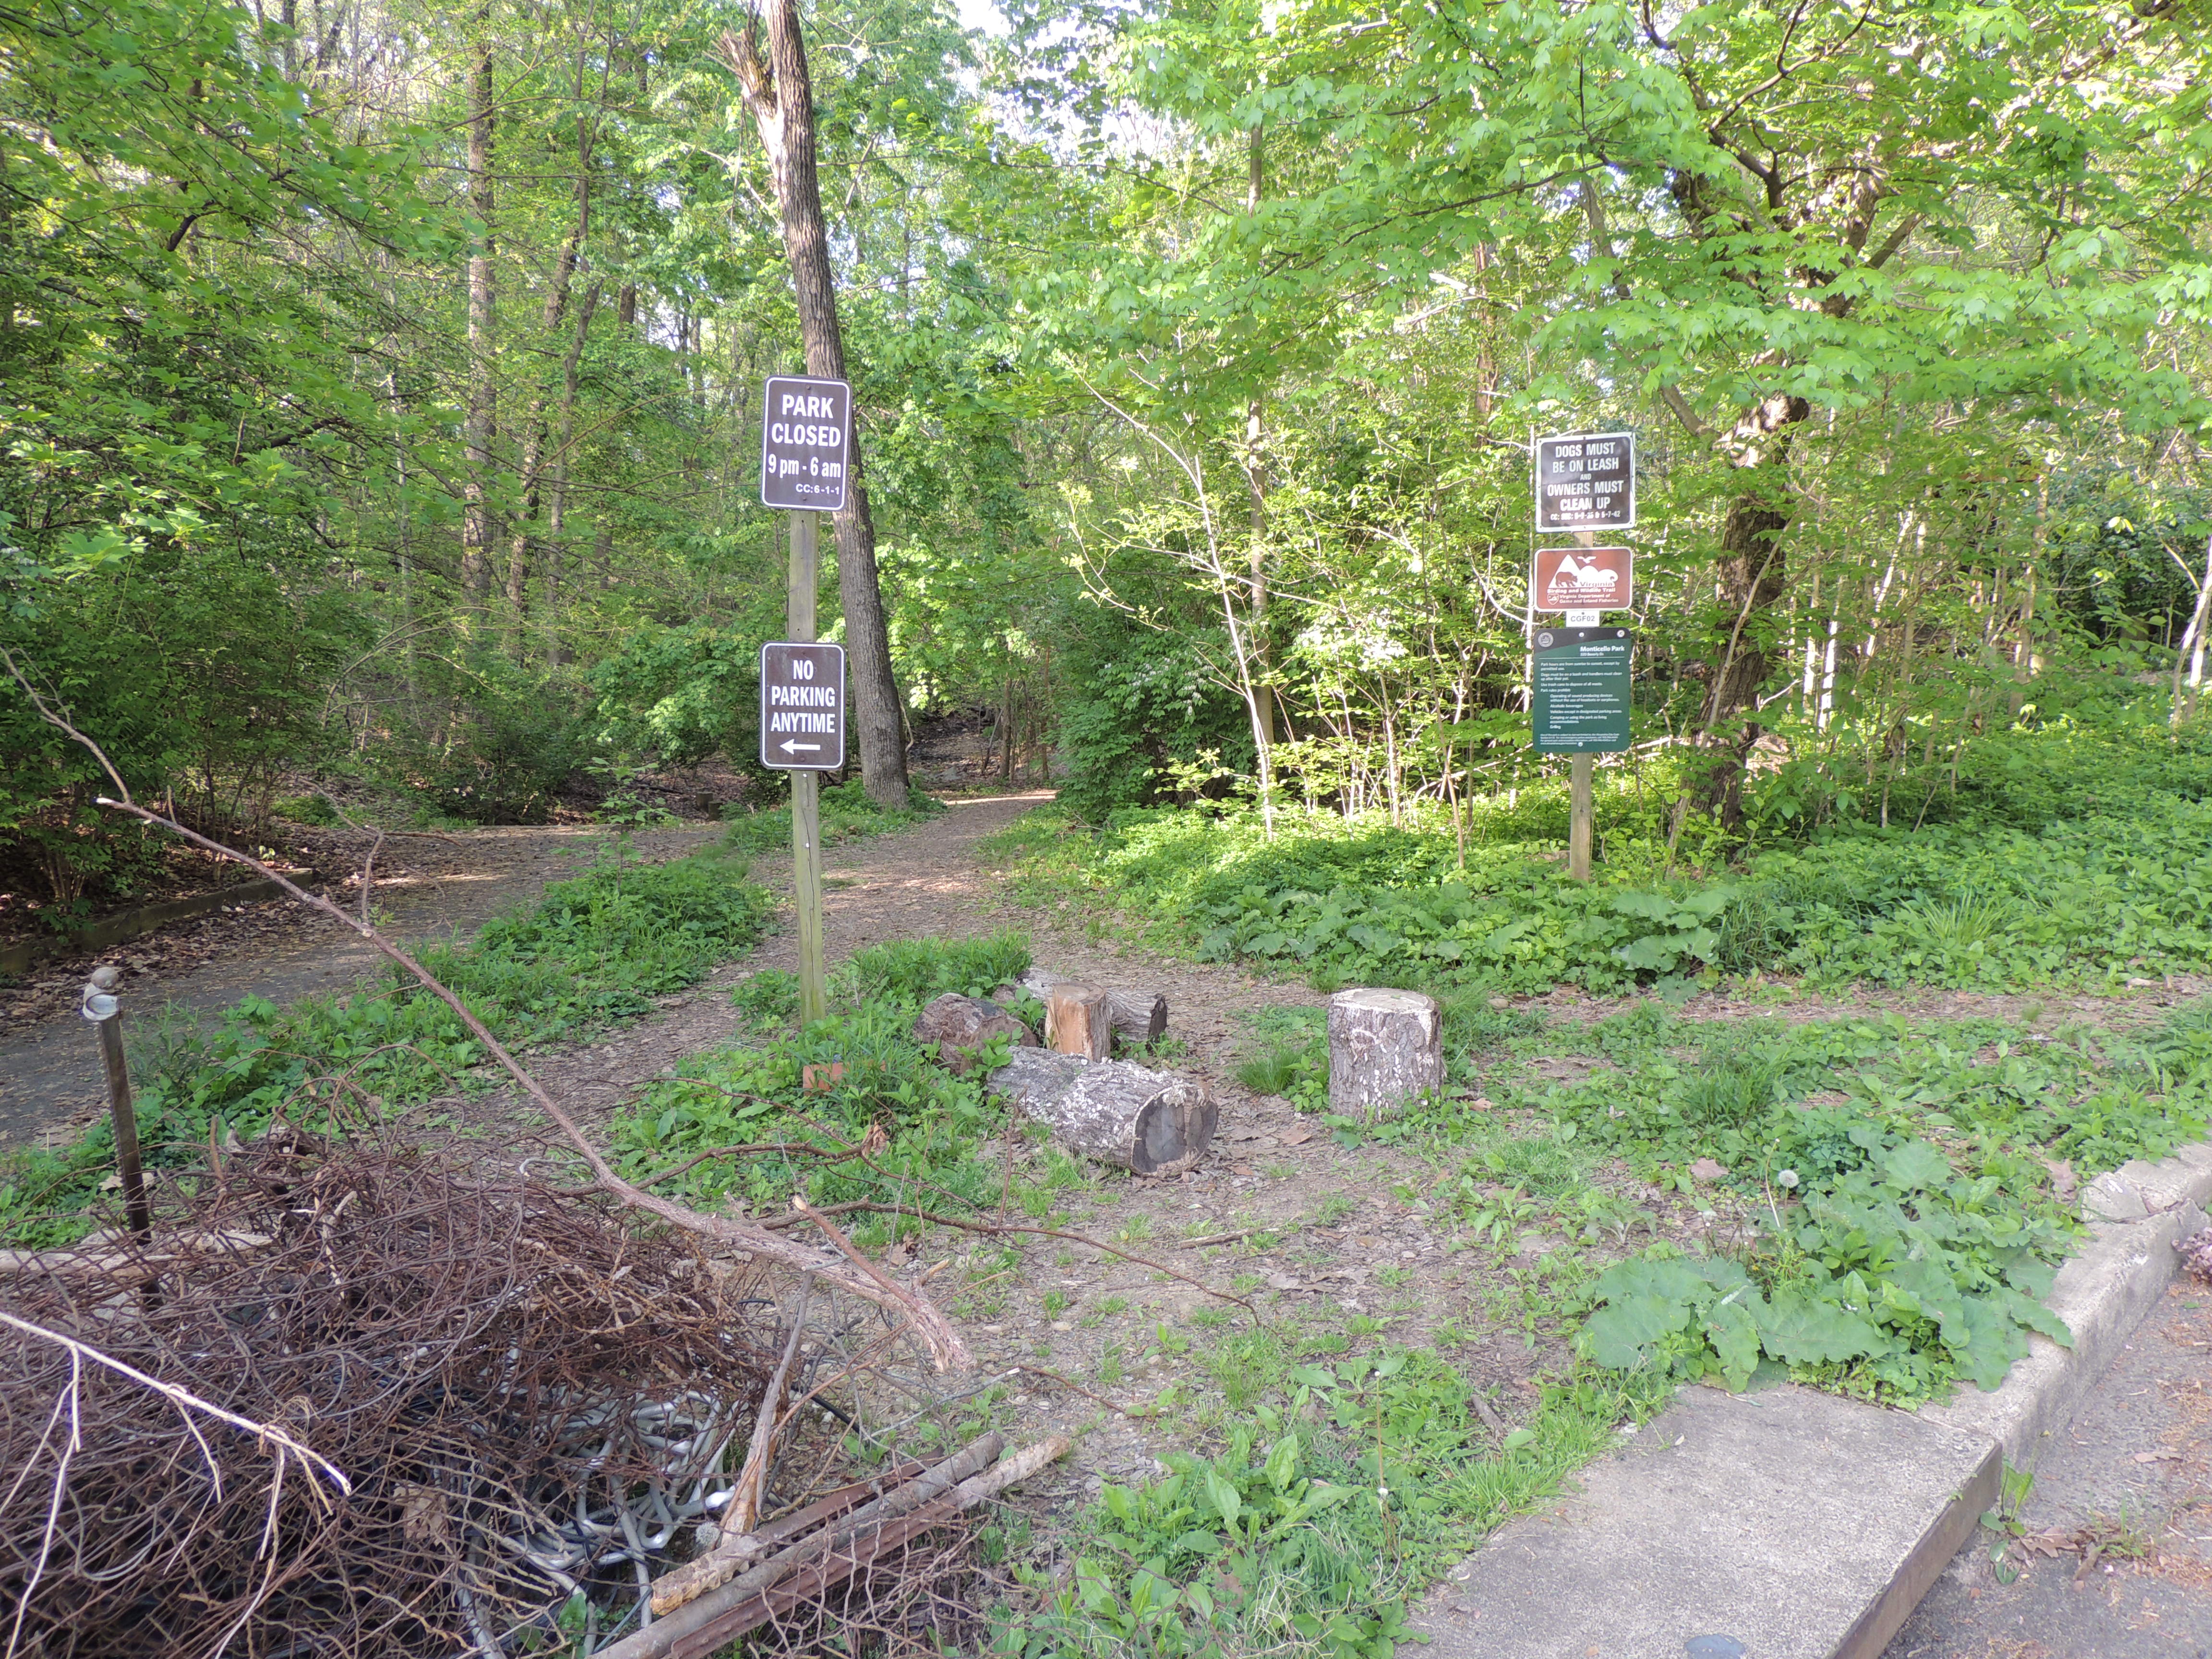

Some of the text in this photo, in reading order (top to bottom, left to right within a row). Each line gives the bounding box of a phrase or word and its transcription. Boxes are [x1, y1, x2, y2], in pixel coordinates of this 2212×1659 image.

[782, 394, 834, 419] PARK
[771, 422, 841, 447] CLOSED
[1555, 442, 1616, 458] DOGS MUST
[768, 454, 777, 474] 9
[779, 459, 799, 479] pm
[810, 457, 819, 476] 6
[821, 461, 841, 478] am
[1552, 457, 1620, 473] BE ON LEASH
[795, 484, 840, 495] CC:6-1-1
[1547, 480, 1624, 496] OWNERS MUST
[1560, 496, 1611, 511] CLEAN UP
[793, 660, 814, 680] NO
[771, 685, 836, 707] PARKING
[770, 712, 836, 733] ANYTIME
